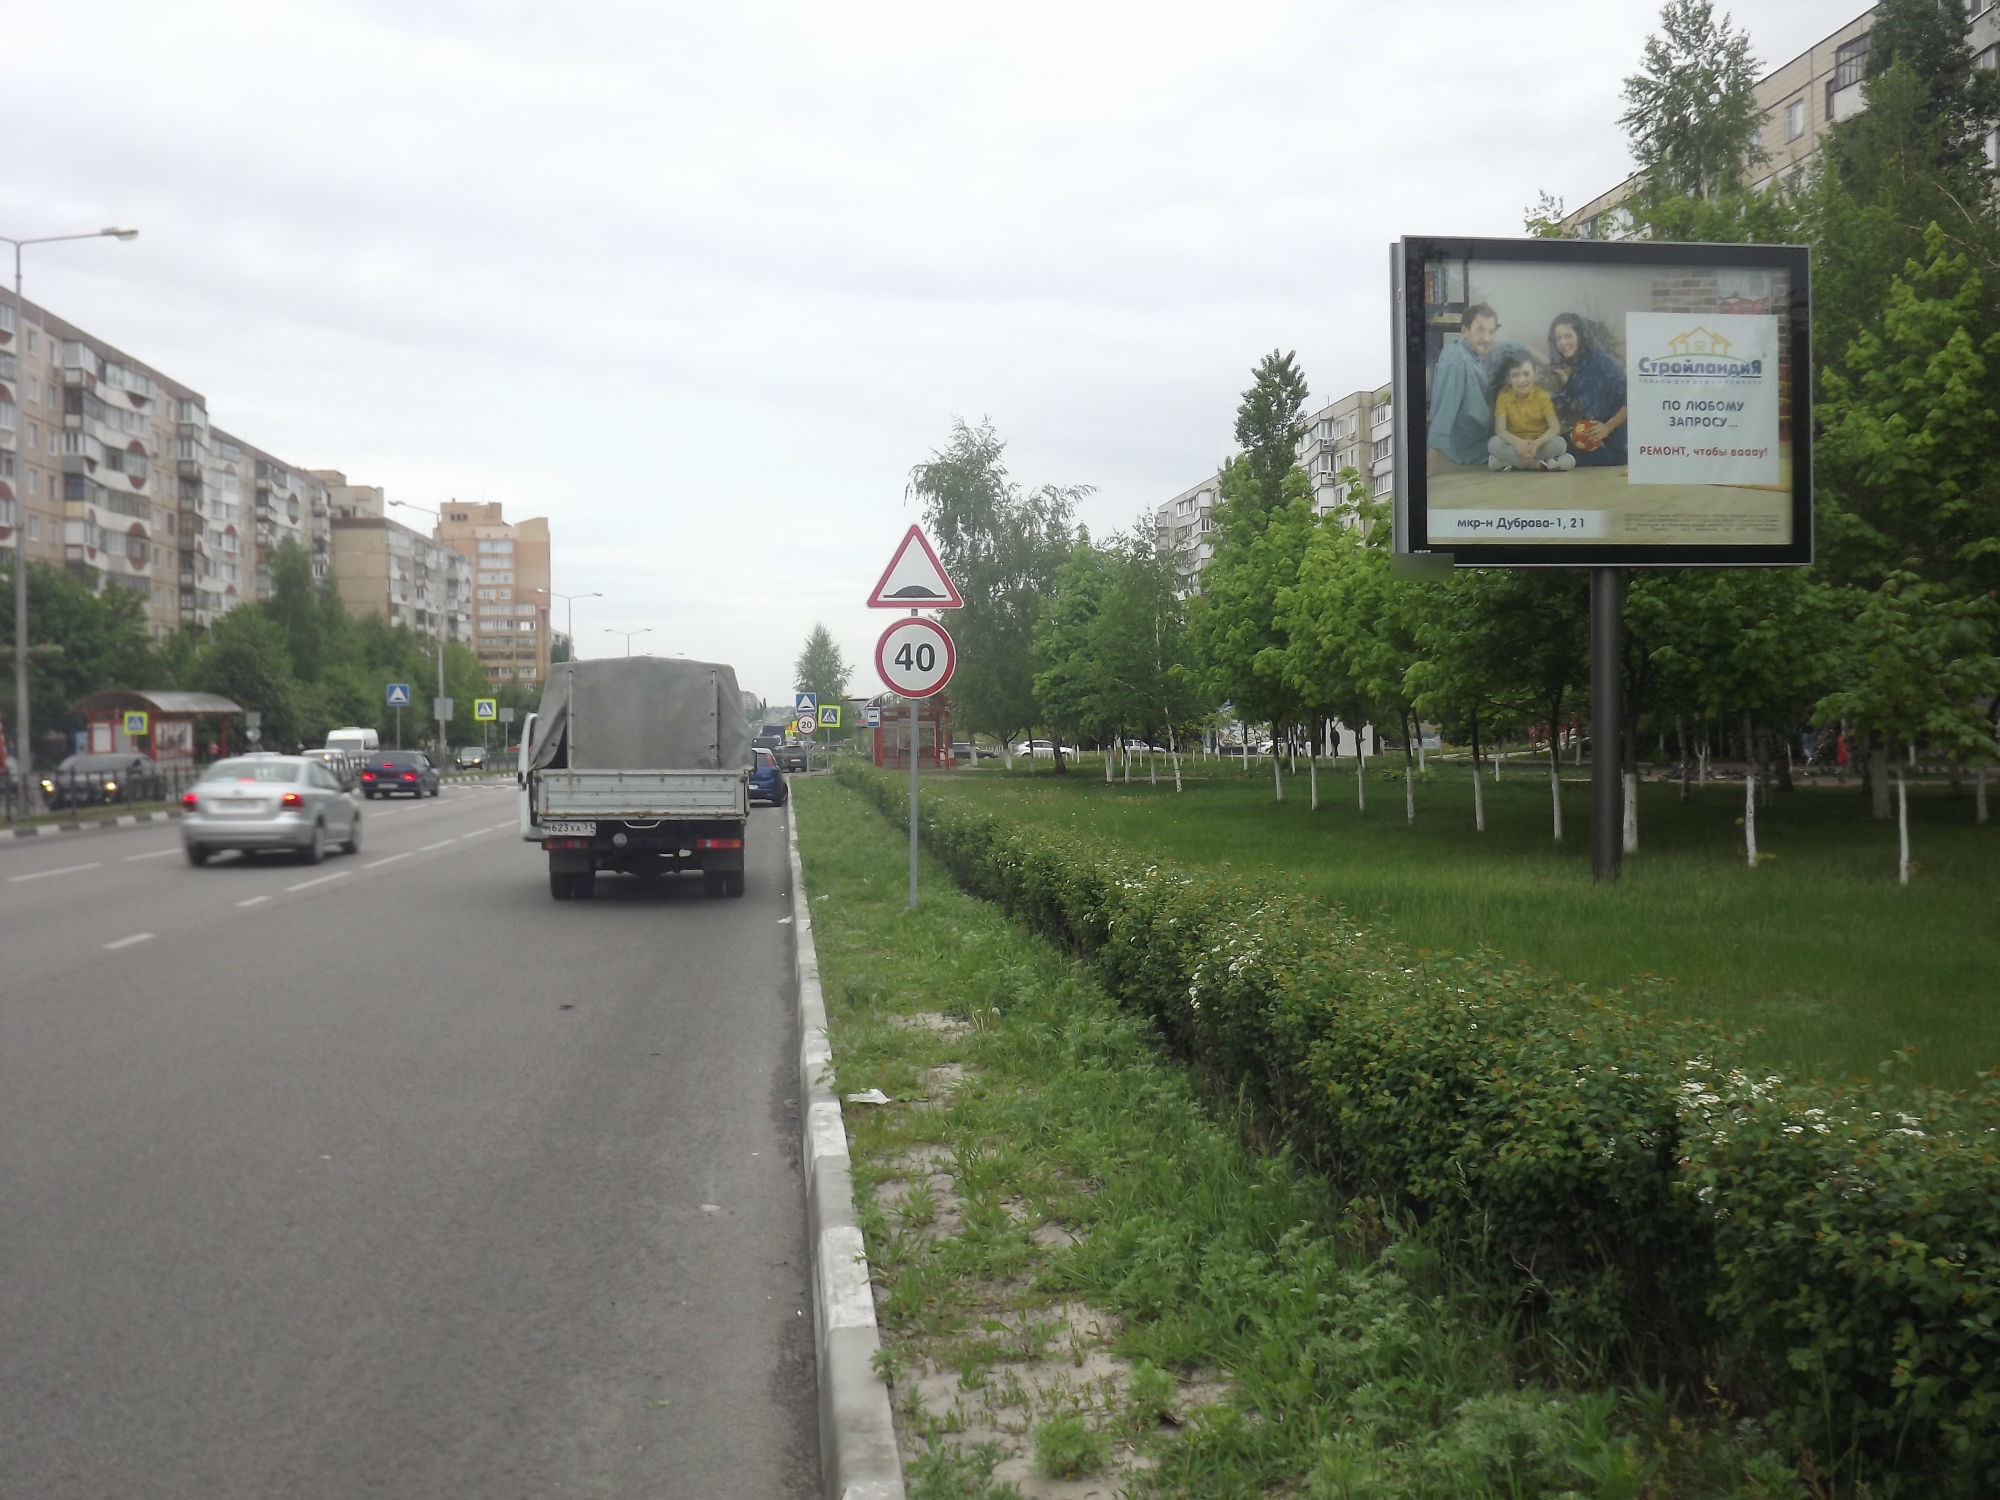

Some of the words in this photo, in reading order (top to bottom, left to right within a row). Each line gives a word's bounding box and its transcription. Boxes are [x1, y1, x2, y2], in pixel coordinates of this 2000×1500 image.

[1662, 400, 1681, 411] ПО
[1685, 400, 1744, 412] ЛЮБОМУ
[1669, 416, 1738, 428] ЗАПРОСУ...
[1639, 446, 1690, 457] РЕМОНТ,
[1693, 446, 1727, 457] чтобы
[1457, 519, 1493, 530] мкр-н
[1496, 517, 1566, 531] Дубрава-1,
[1570, 517, 1585, 529] 21
[894, 643, 935, 672] 40
[801, 721, 813, 729] 20
